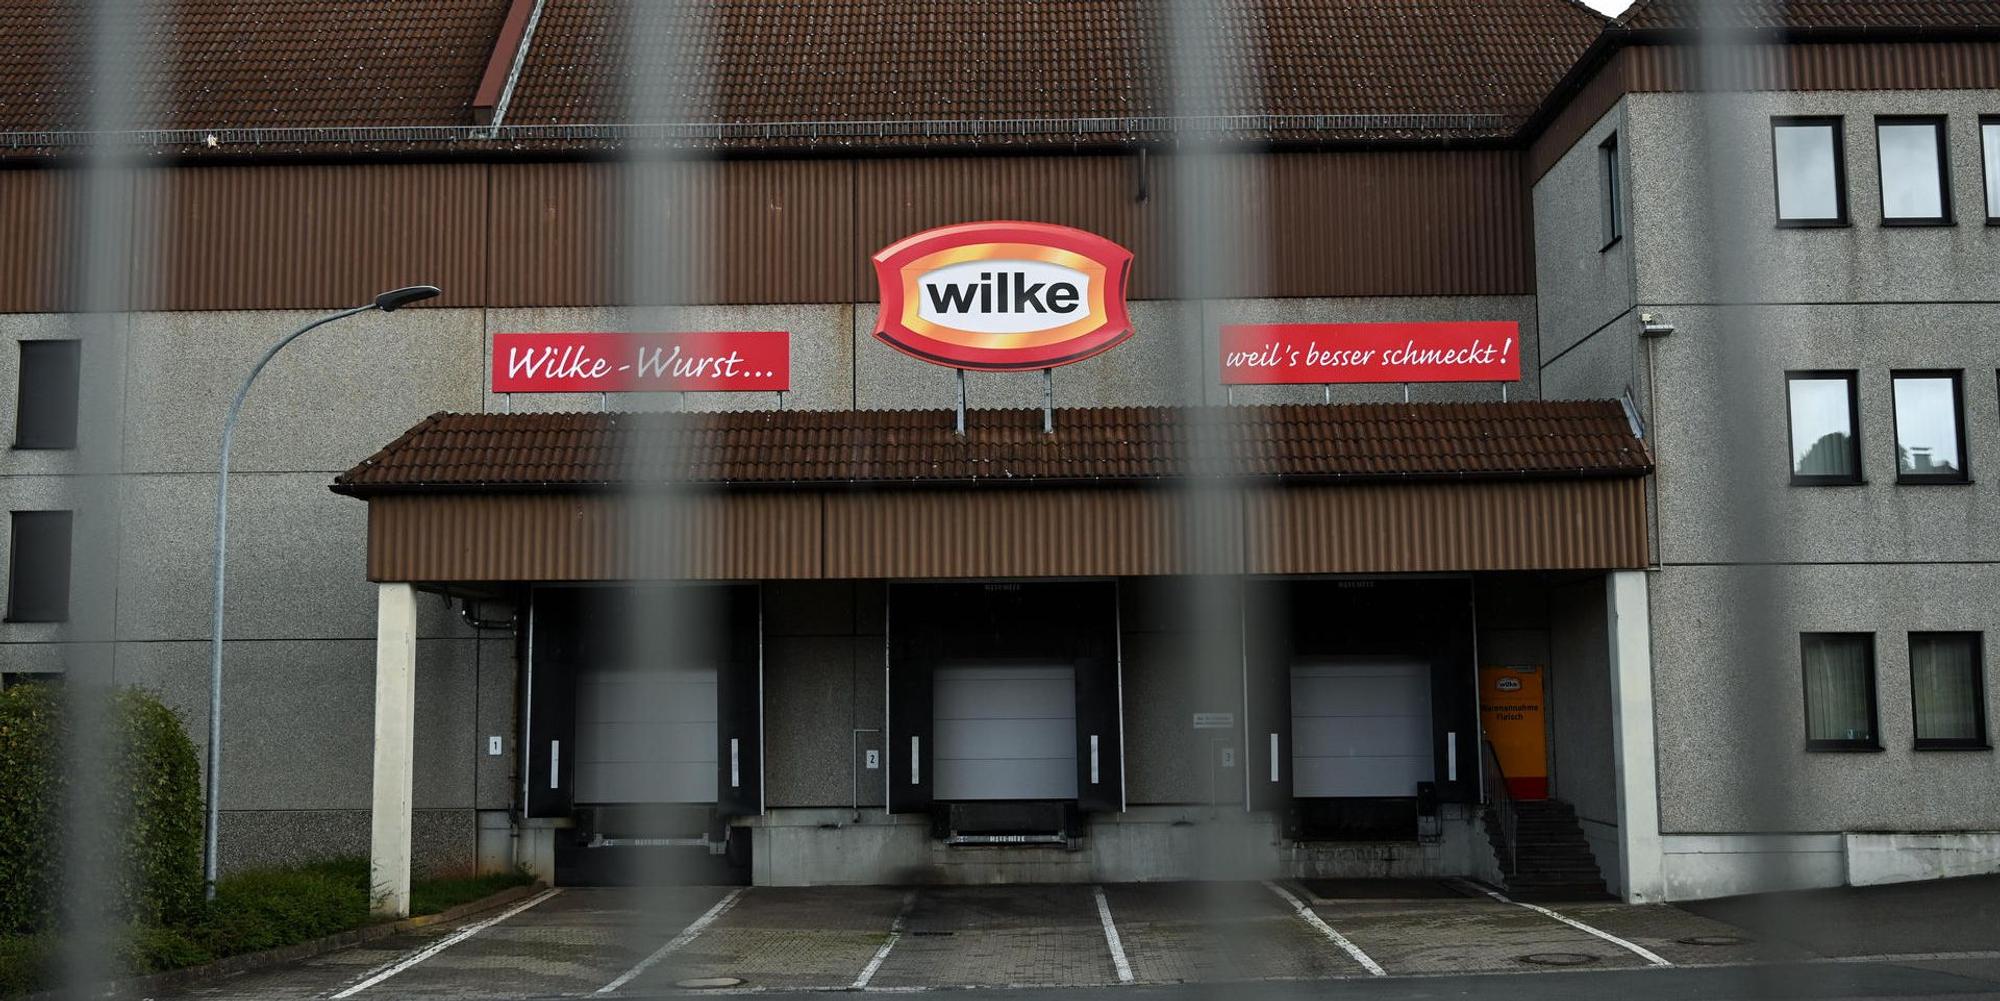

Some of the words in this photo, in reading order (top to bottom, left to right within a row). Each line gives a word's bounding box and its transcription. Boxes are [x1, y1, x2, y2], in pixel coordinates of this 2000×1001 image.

[926, 272, 1080, 314] wilke
[1226, 342, 1300, 367] weil's
[1306, 341, 1375, 367] besser
[1381, 338, 1513, 365] schmeckt!
[870, 755, 875, 764] 2
